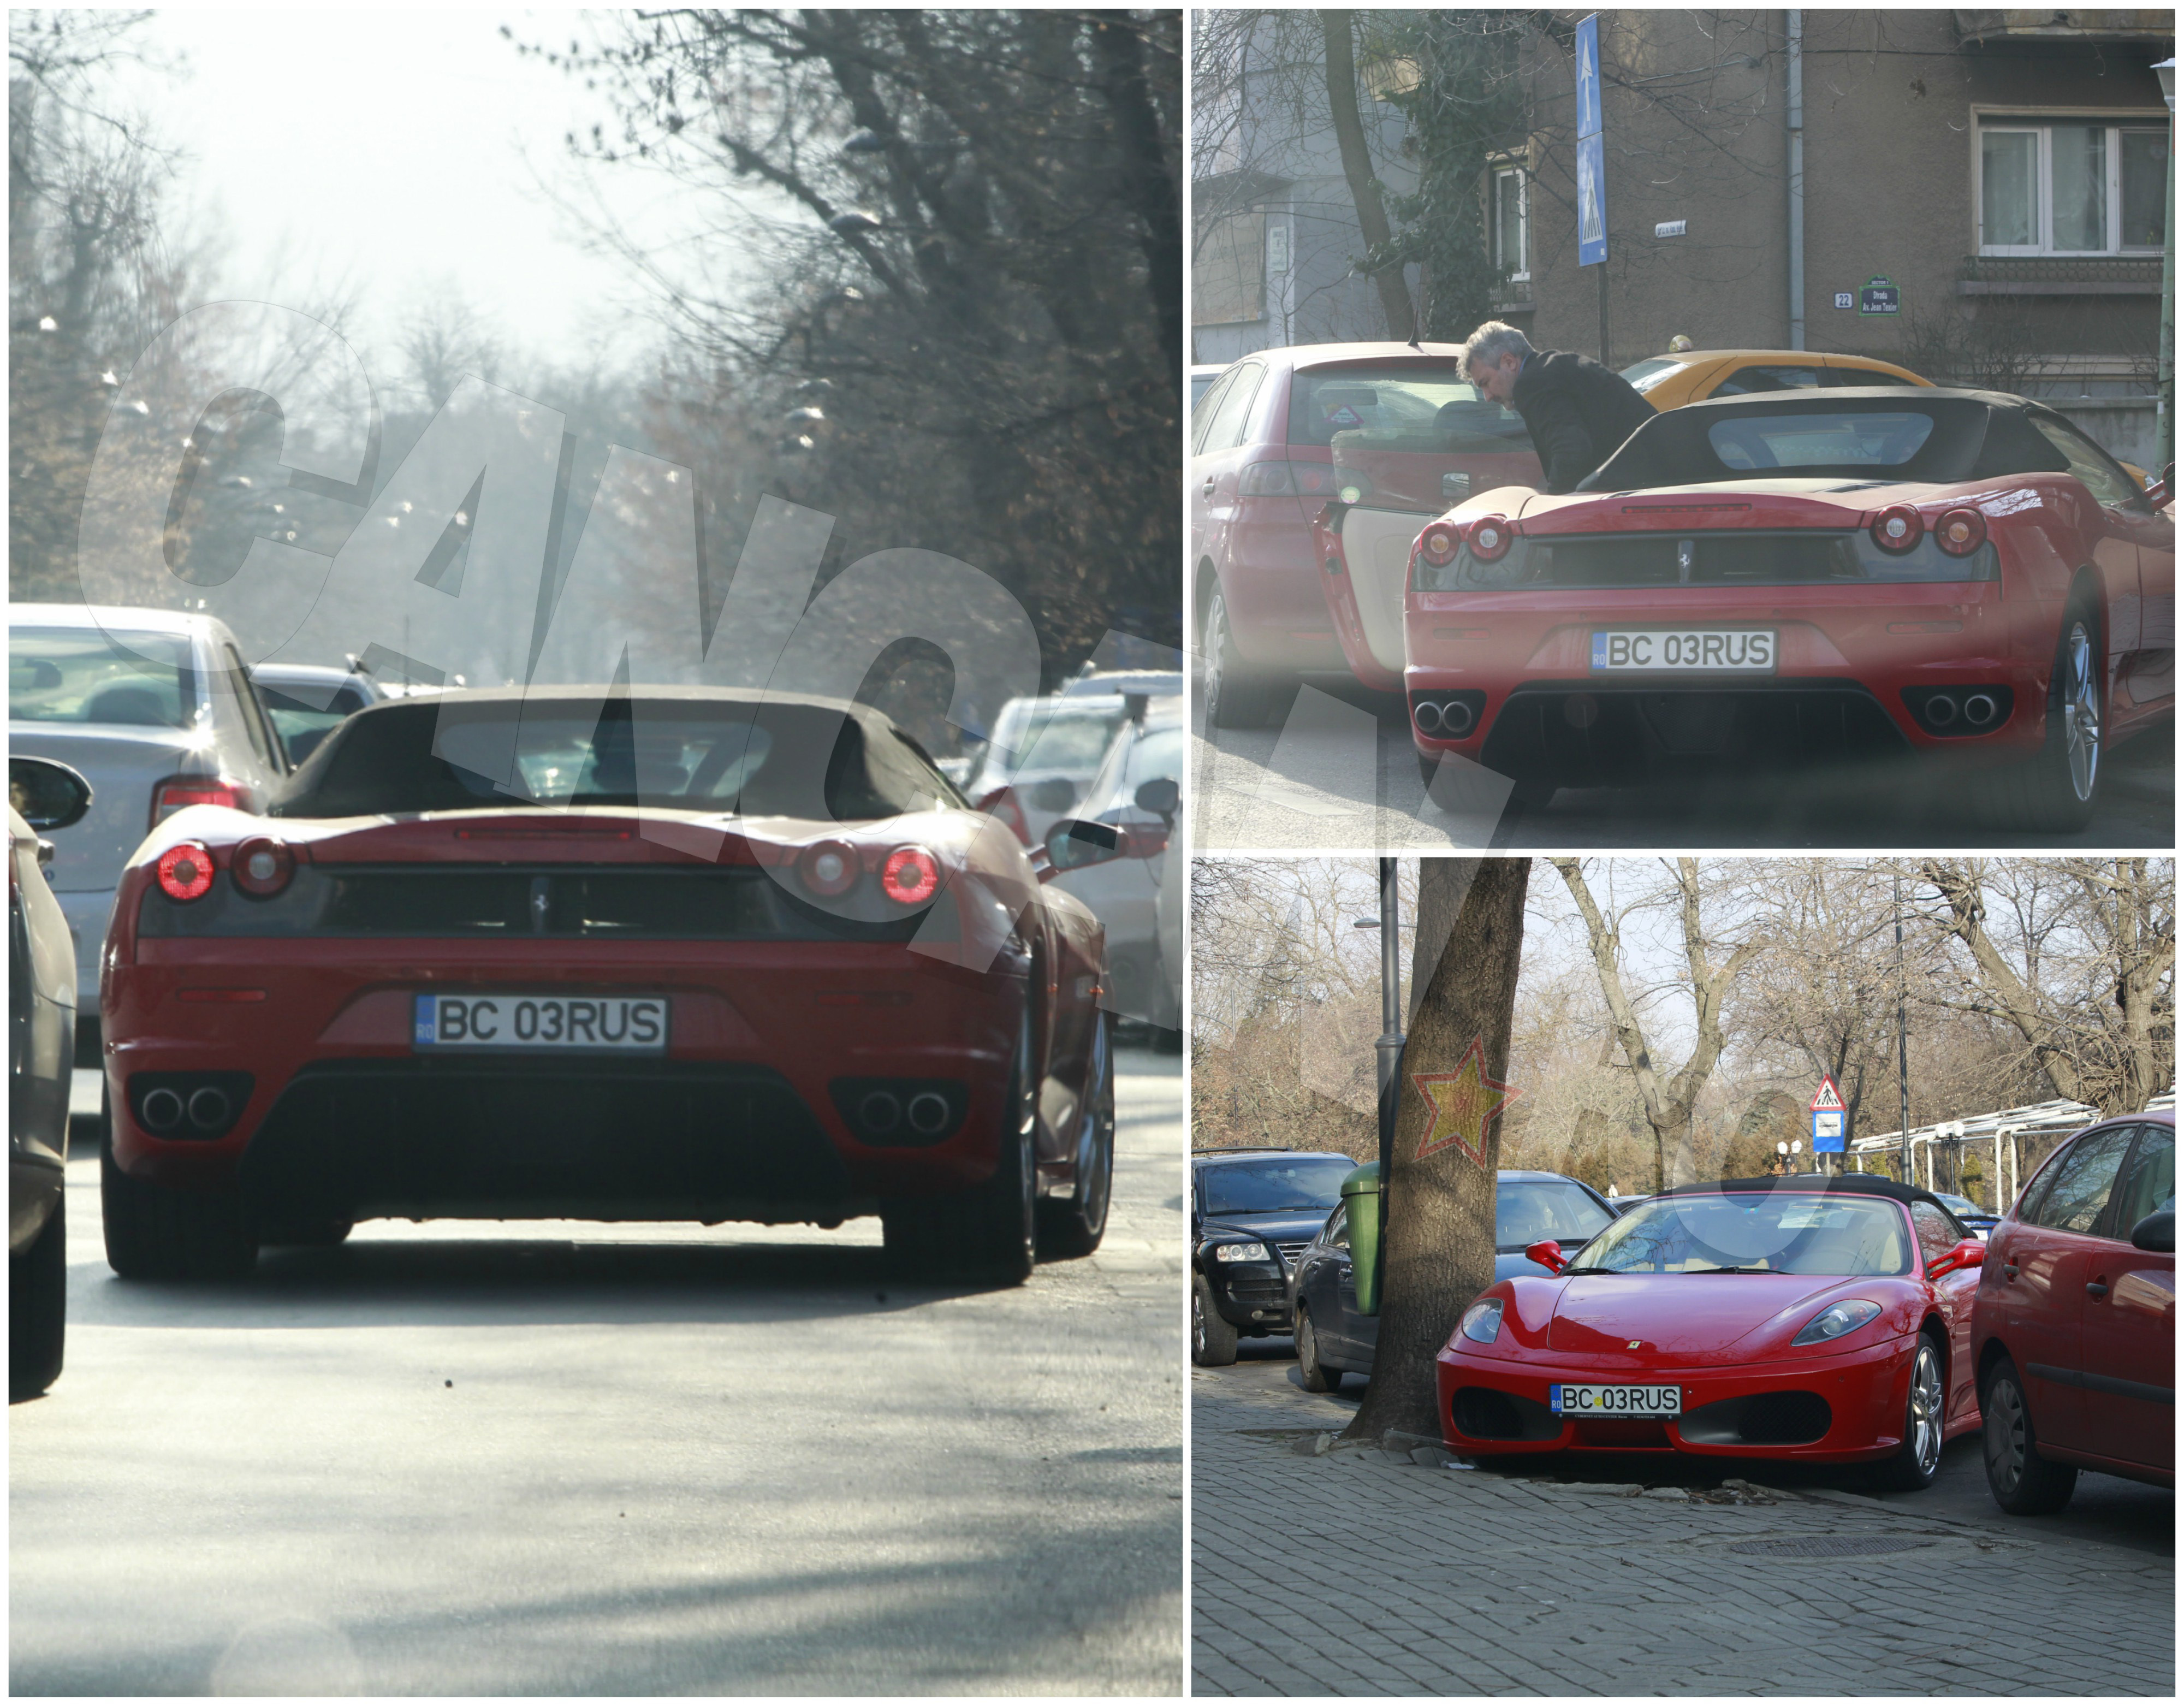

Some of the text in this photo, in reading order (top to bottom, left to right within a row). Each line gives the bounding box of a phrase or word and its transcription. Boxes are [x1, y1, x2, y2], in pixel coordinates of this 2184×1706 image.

[1838, 294, 1849, 306] 22
[1873, 291, 1888, 299] Strada
[1871, 303, 1882, 311] Jean
[1882, 303, 1897, 311] Texier
[1609, 635, 1770, 666] BC 03RUS
[1593, 654, 1605, 666] RO
[440, 999, 661, 1042] BC 03RUS
[416, 1023, 434, 1039] RO
[1552, 1400, 1561, 1409] RO
[1563, 1388, 1678, 1410] BC 03RUS
